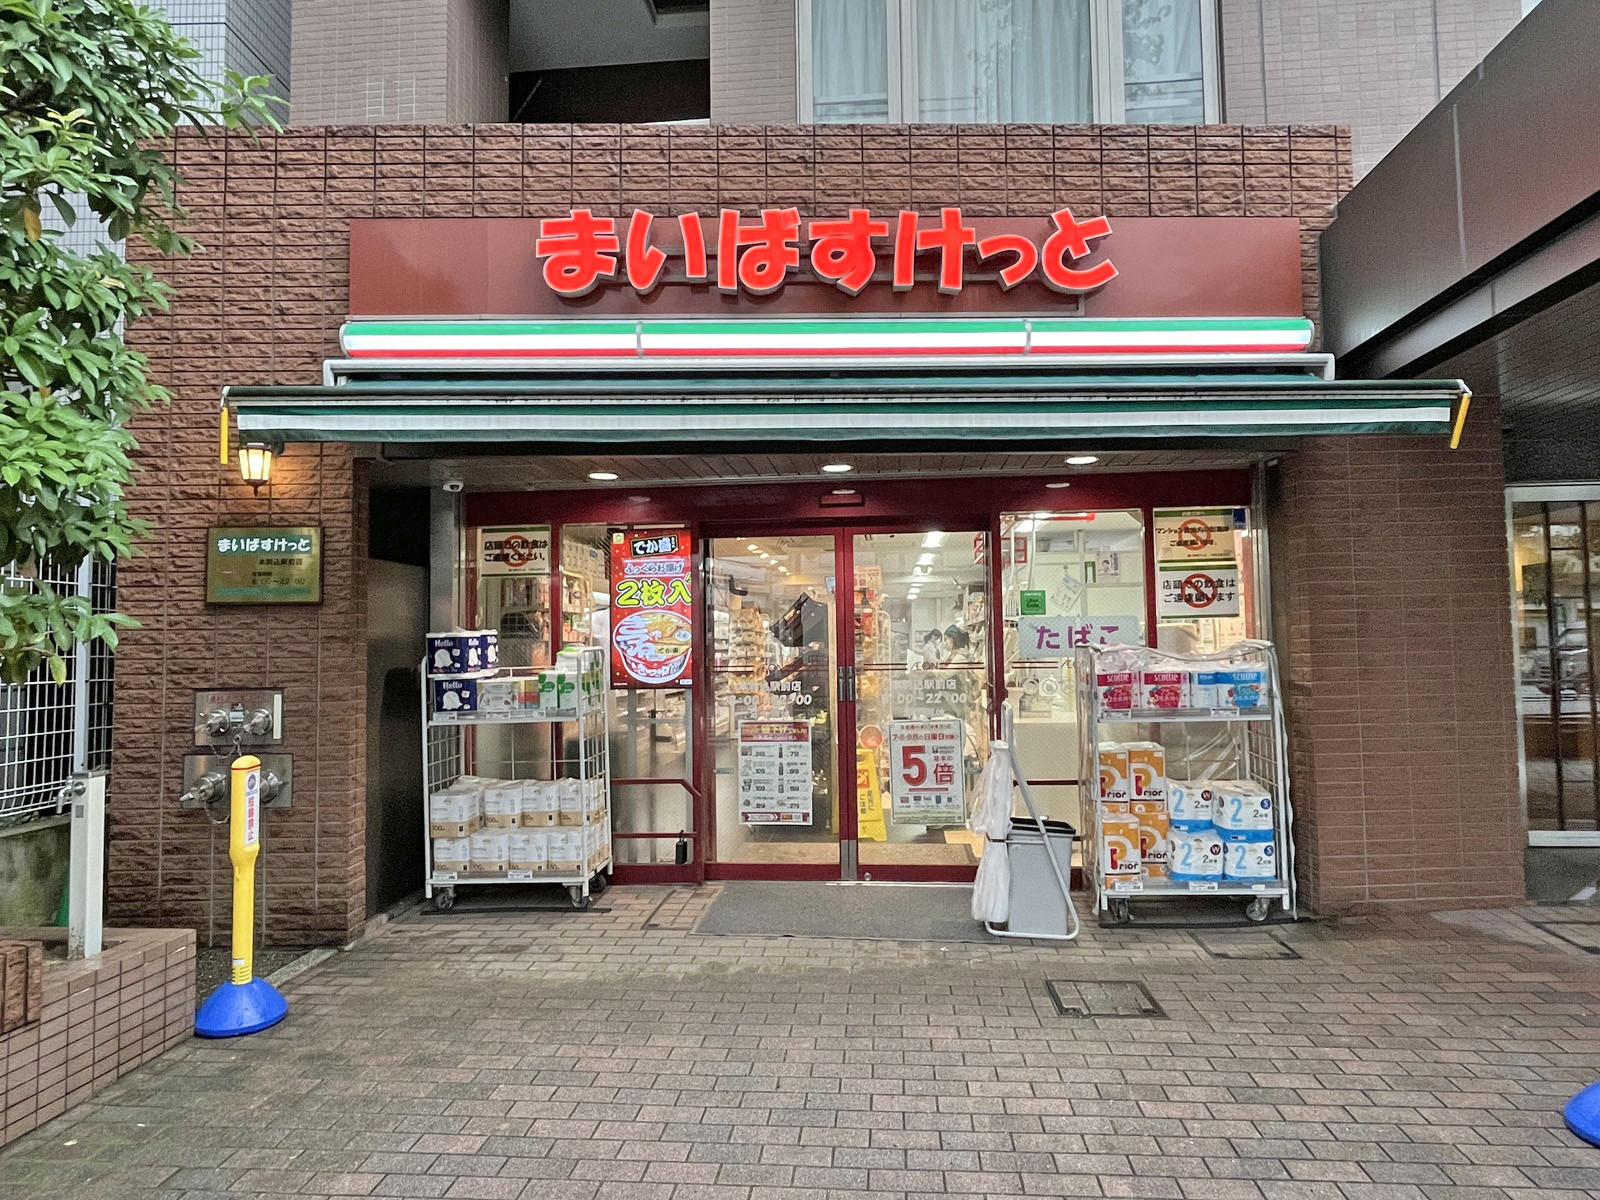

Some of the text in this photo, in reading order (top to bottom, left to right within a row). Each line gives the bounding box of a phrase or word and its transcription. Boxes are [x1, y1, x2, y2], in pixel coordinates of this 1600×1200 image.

[535, 207, 1120, 296] まいばすけっと
[218, 538, 310, 552] まいばすけっと
[434, 639, 454, 647] Hello
[443, 681, 463, 690] Hello
[902, 746, 927, 787] 5
[933, 763, 955, 785] 倍
[1133, 767, 1164, 796] Prior
[1172, 788, 1184, 813] 2
[1230, 797, 1243, 823] 2
[1108, 840, 1139, 870] Prior
[1180, 842, 1192, 866] 2
[1234, 845, 1247, 870] 2
